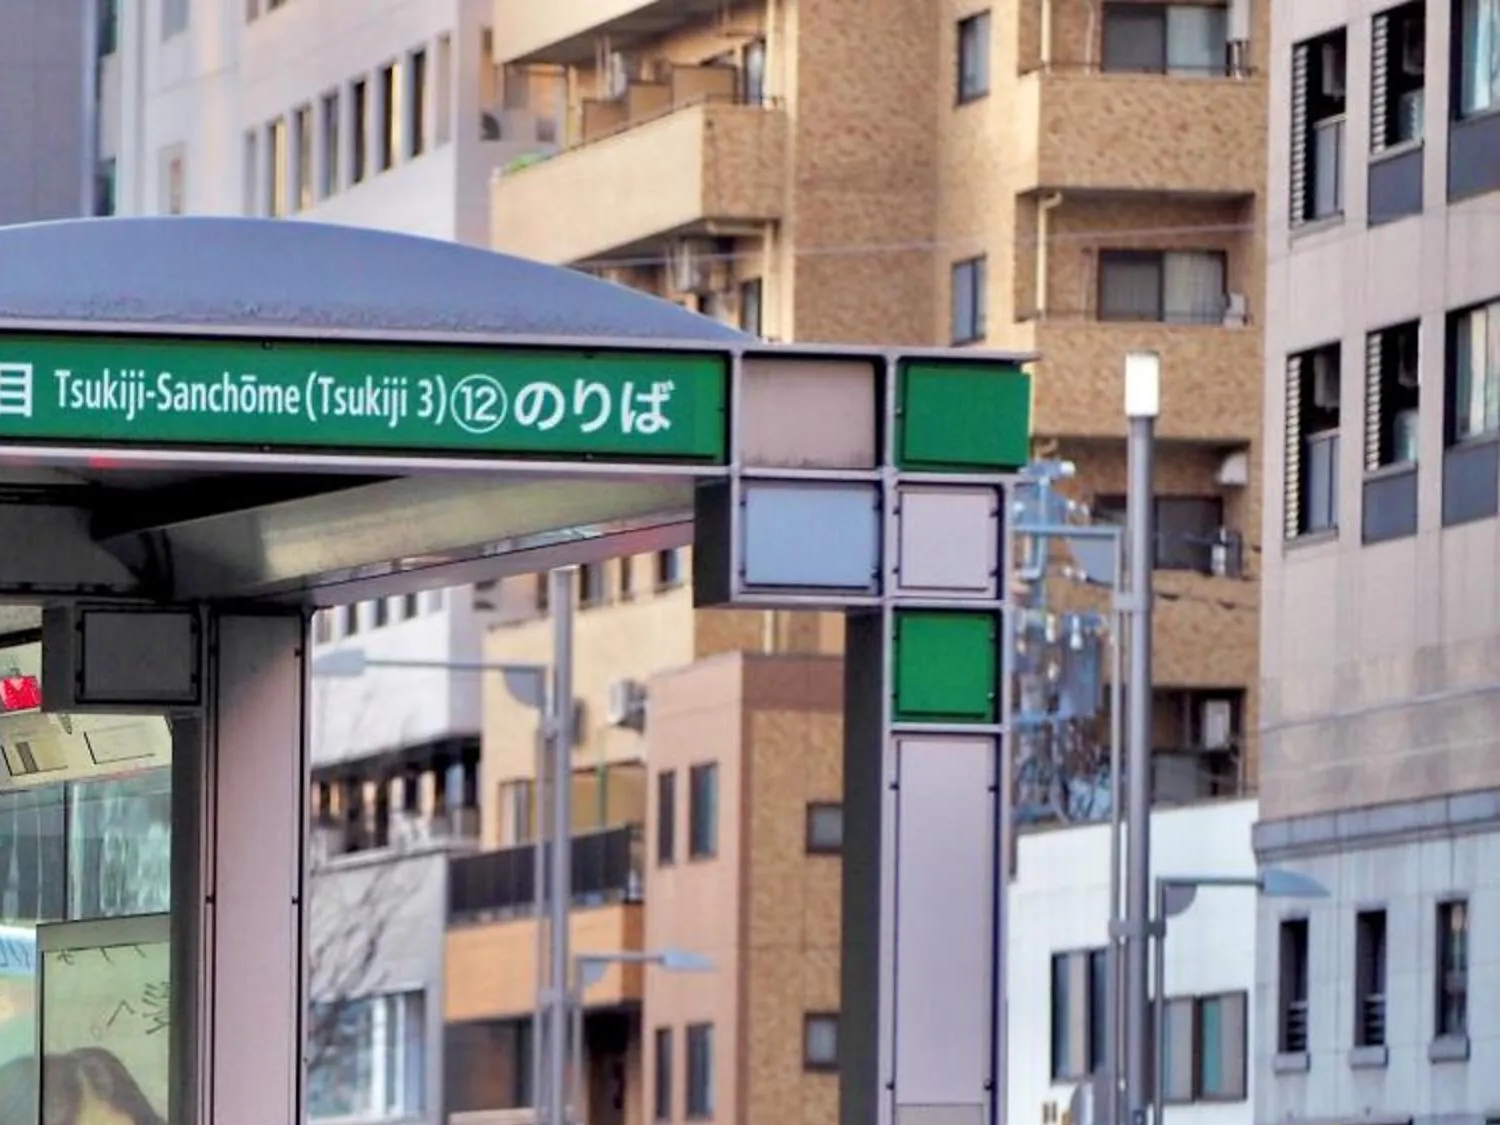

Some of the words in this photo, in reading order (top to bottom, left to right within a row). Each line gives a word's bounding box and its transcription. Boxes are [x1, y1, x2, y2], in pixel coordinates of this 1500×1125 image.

[55, 369, 299, 420] Tsukiji-Sanchōme
[514, 378, 675, 434] のりば
